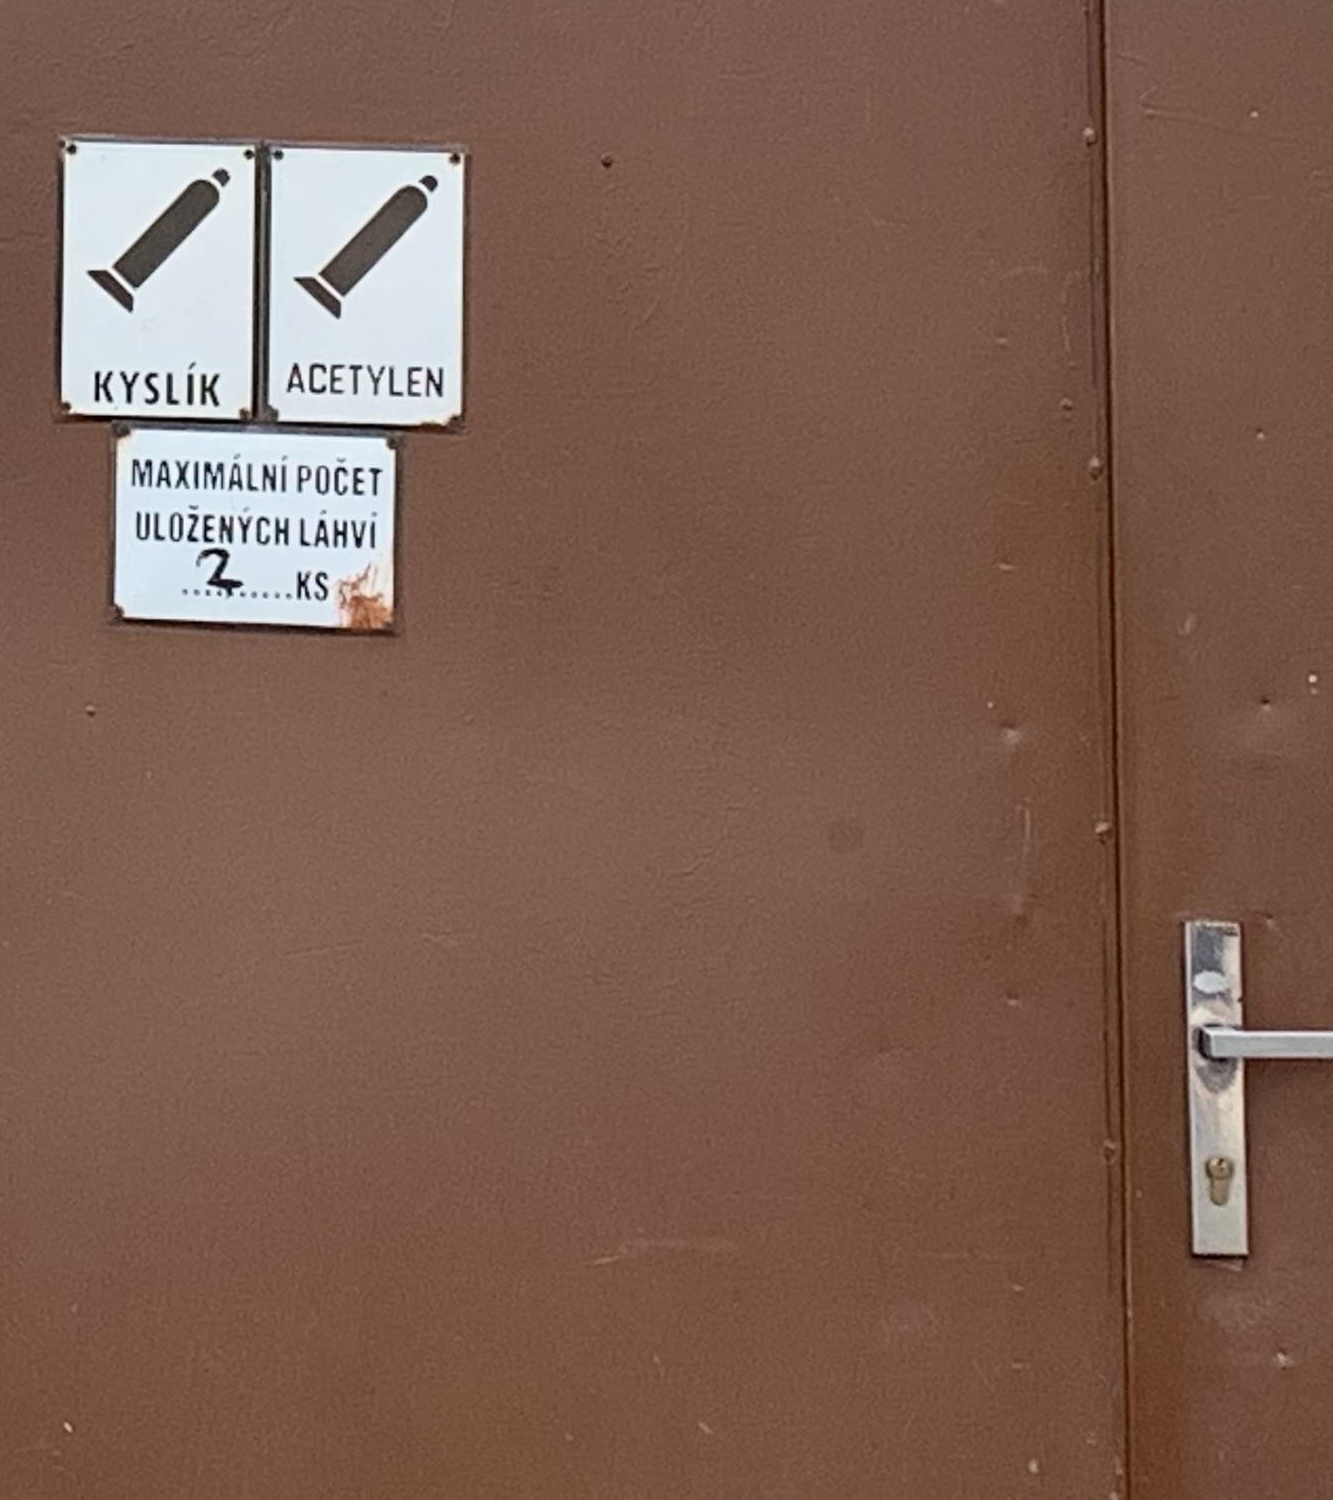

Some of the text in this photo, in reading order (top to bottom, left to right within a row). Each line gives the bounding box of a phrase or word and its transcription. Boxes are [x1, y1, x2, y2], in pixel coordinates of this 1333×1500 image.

[94, 362, 220, 407] KYSLÍK
[286, 363, 443, 397] ACETYLEN
[132, 454, 383, 496] MAXIMÁLNÍ POČET
[136, 505, 289, 546] ULOŽENÝCH
[195, 548, 243, 592] 2
